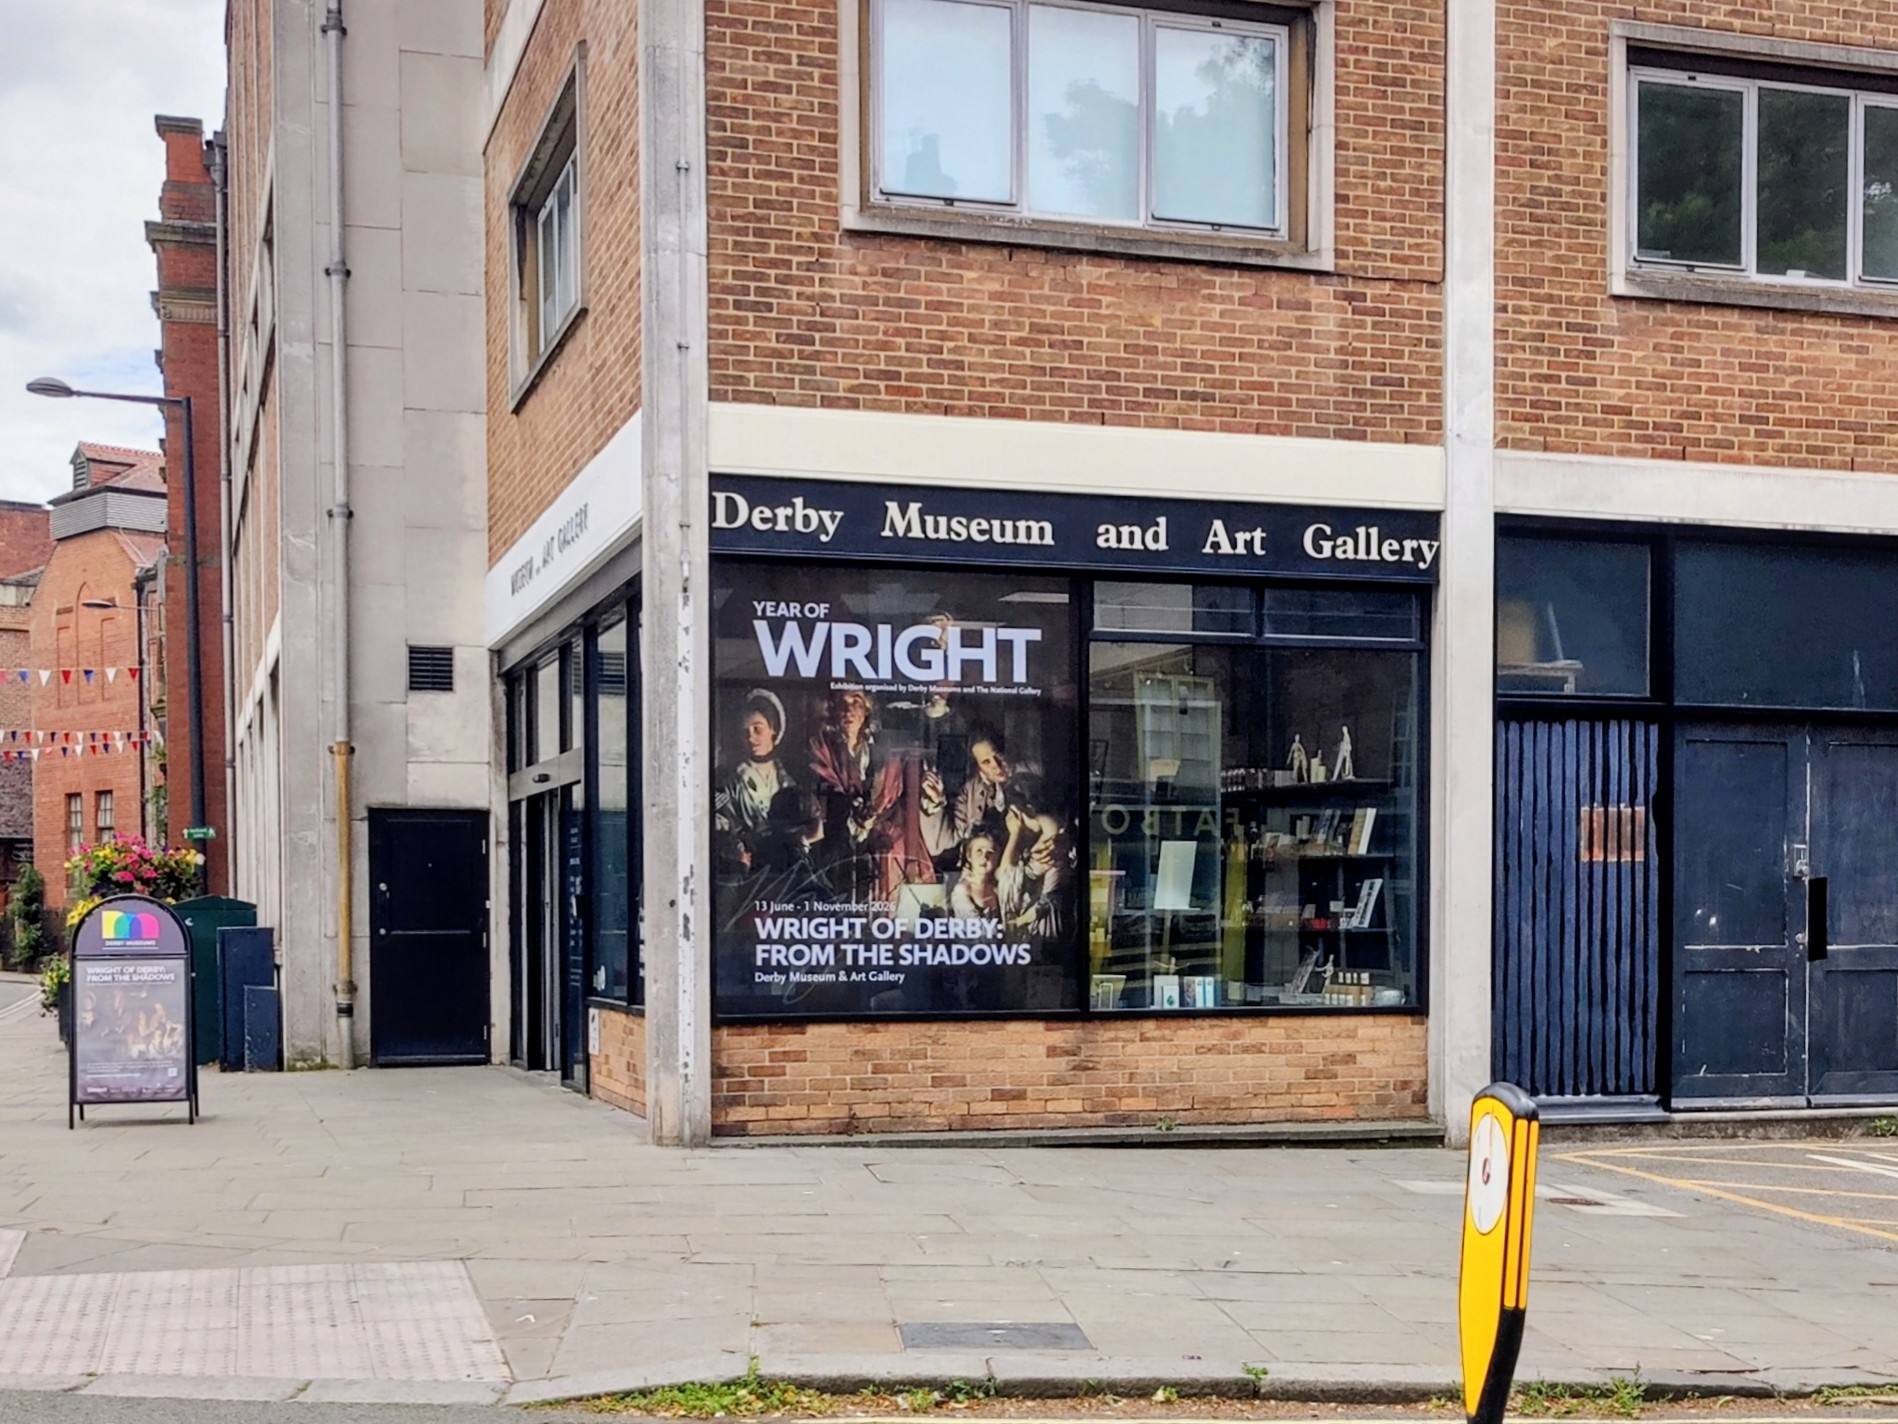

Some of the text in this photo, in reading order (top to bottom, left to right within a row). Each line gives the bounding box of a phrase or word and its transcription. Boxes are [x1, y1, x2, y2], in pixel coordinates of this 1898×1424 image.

[711, 491, 1440, 569] Derby Museum and Art Gallery
[752, 600, 830, 619] YEAR OF
[752, 619, 1042, 684] WRIGHT
[830, 682, 864, 691] Exhibition
[865, 683, 898, 693] organised
[899, 683, 907, 693] by
[908, 684, 928, 694] Derby
[963, 685, 975, 694] and
[976, 686, 989, 694] The
[990, 686, 1018, 695] National
[1019, 687, 1042, 696] Gallery
[755, 901, 768, 912] 13
[770, 900, 795, 914] June
[804, 901, 810, 912] 1
[813, 900, 869, 912] November
[871, 901, 897, 912] 2026
[754, 917, 1004, 940] WRIGHT OF DERBY:
[755, 943, 1032, 967] FROM THE SHADOWS
[86, 966, 122, 975] WRIGHT
[122, 966, 136, 975] OF
[86, 972, 176, 983] FROM THE SHADOWS
[754, 970, 906, 985] Derby Museum & Art Gallery
